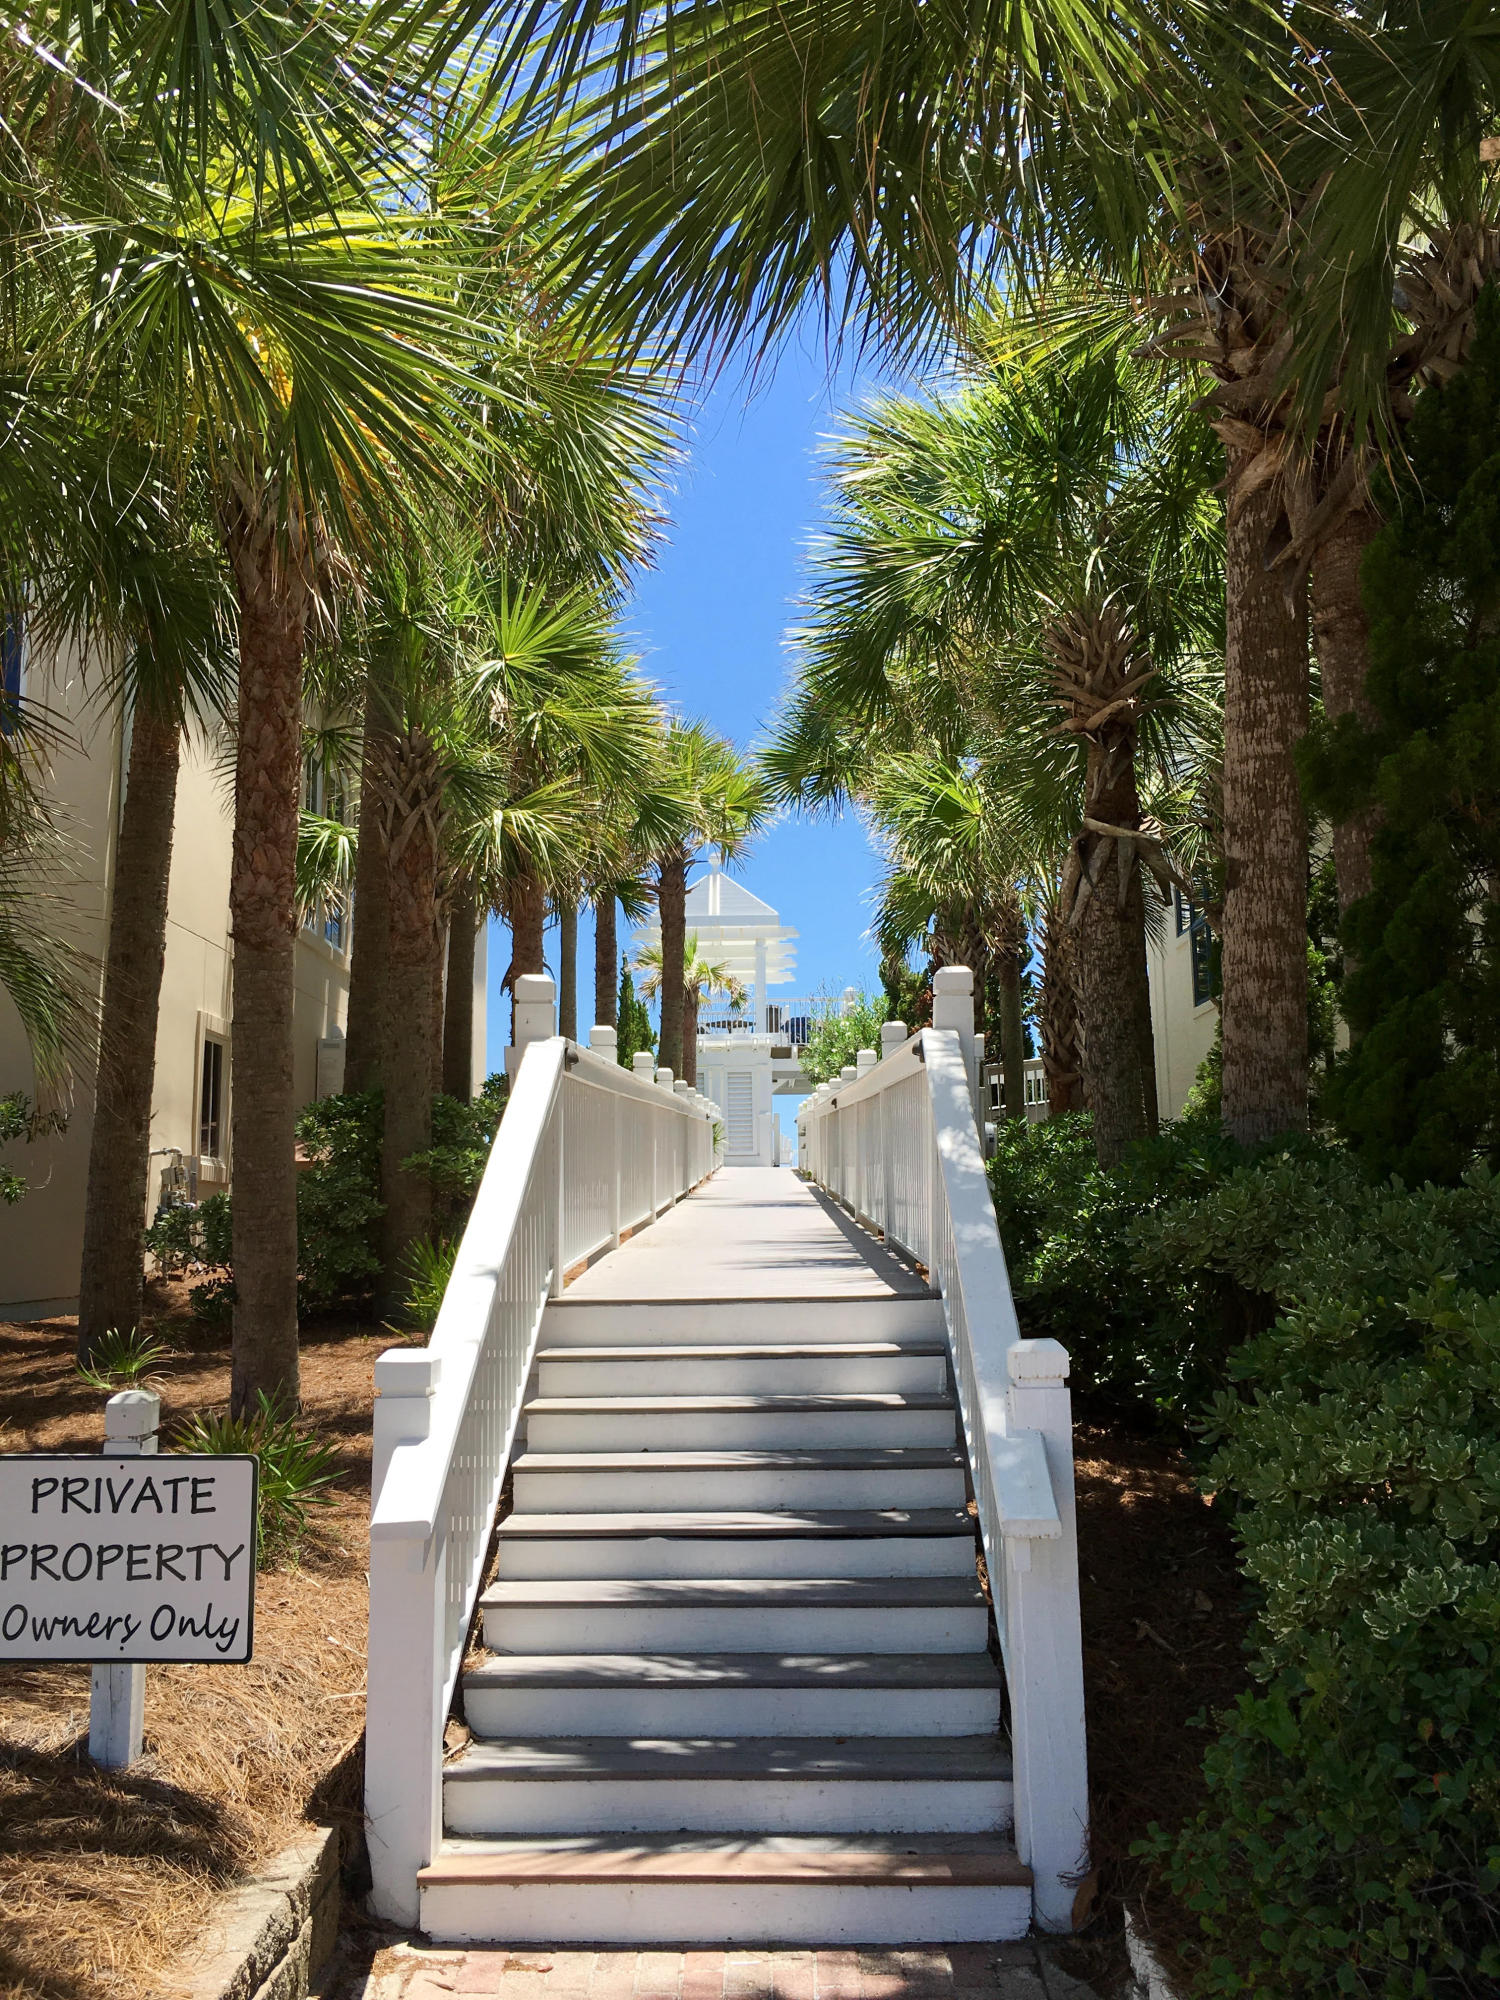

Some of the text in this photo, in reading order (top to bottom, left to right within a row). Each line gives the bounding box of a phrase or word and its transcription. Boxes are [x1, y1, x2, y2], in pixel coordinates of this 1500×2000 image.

[32, 1476, 216, 1514] PRIVATE
[0, 1542, 244, 1581] PROPERTY
[2, 1603, 240, 1652] Owners Only
